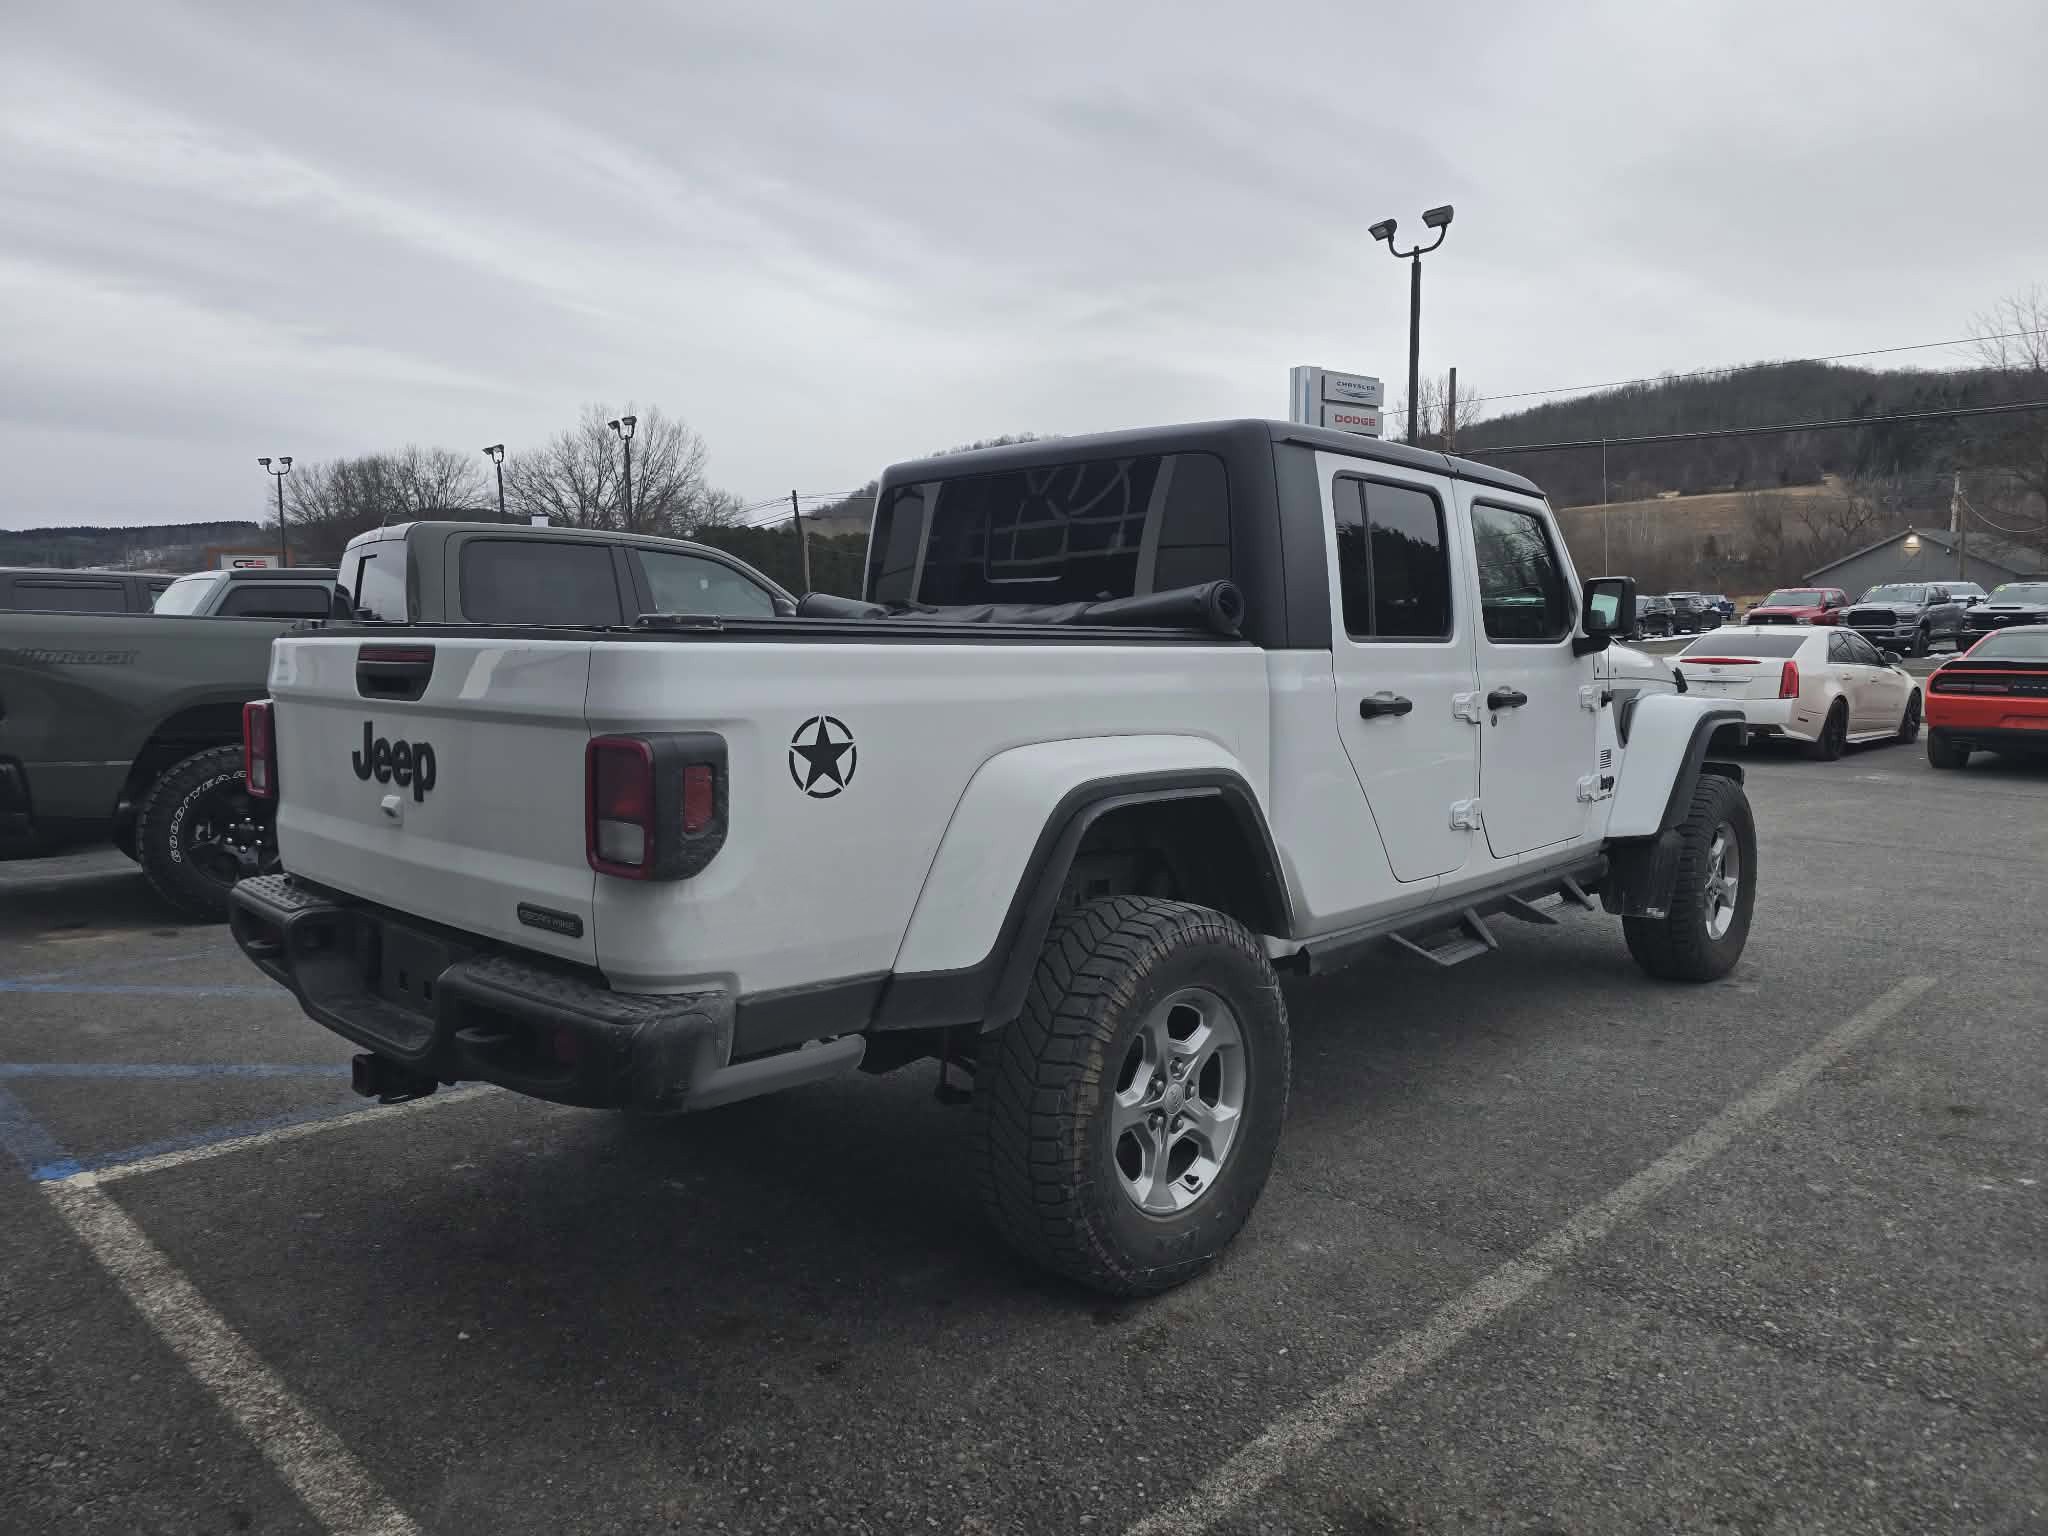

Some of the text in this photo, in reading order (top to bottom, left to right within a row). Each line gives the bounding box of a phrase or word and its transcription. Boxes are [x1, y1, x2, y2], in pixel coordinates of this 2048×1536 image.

[1336, 381, 1376, 391] CHRYSLER
[1334, 415, 1376, 427] DODGE
[352, 720, 436, 802] Jeep
